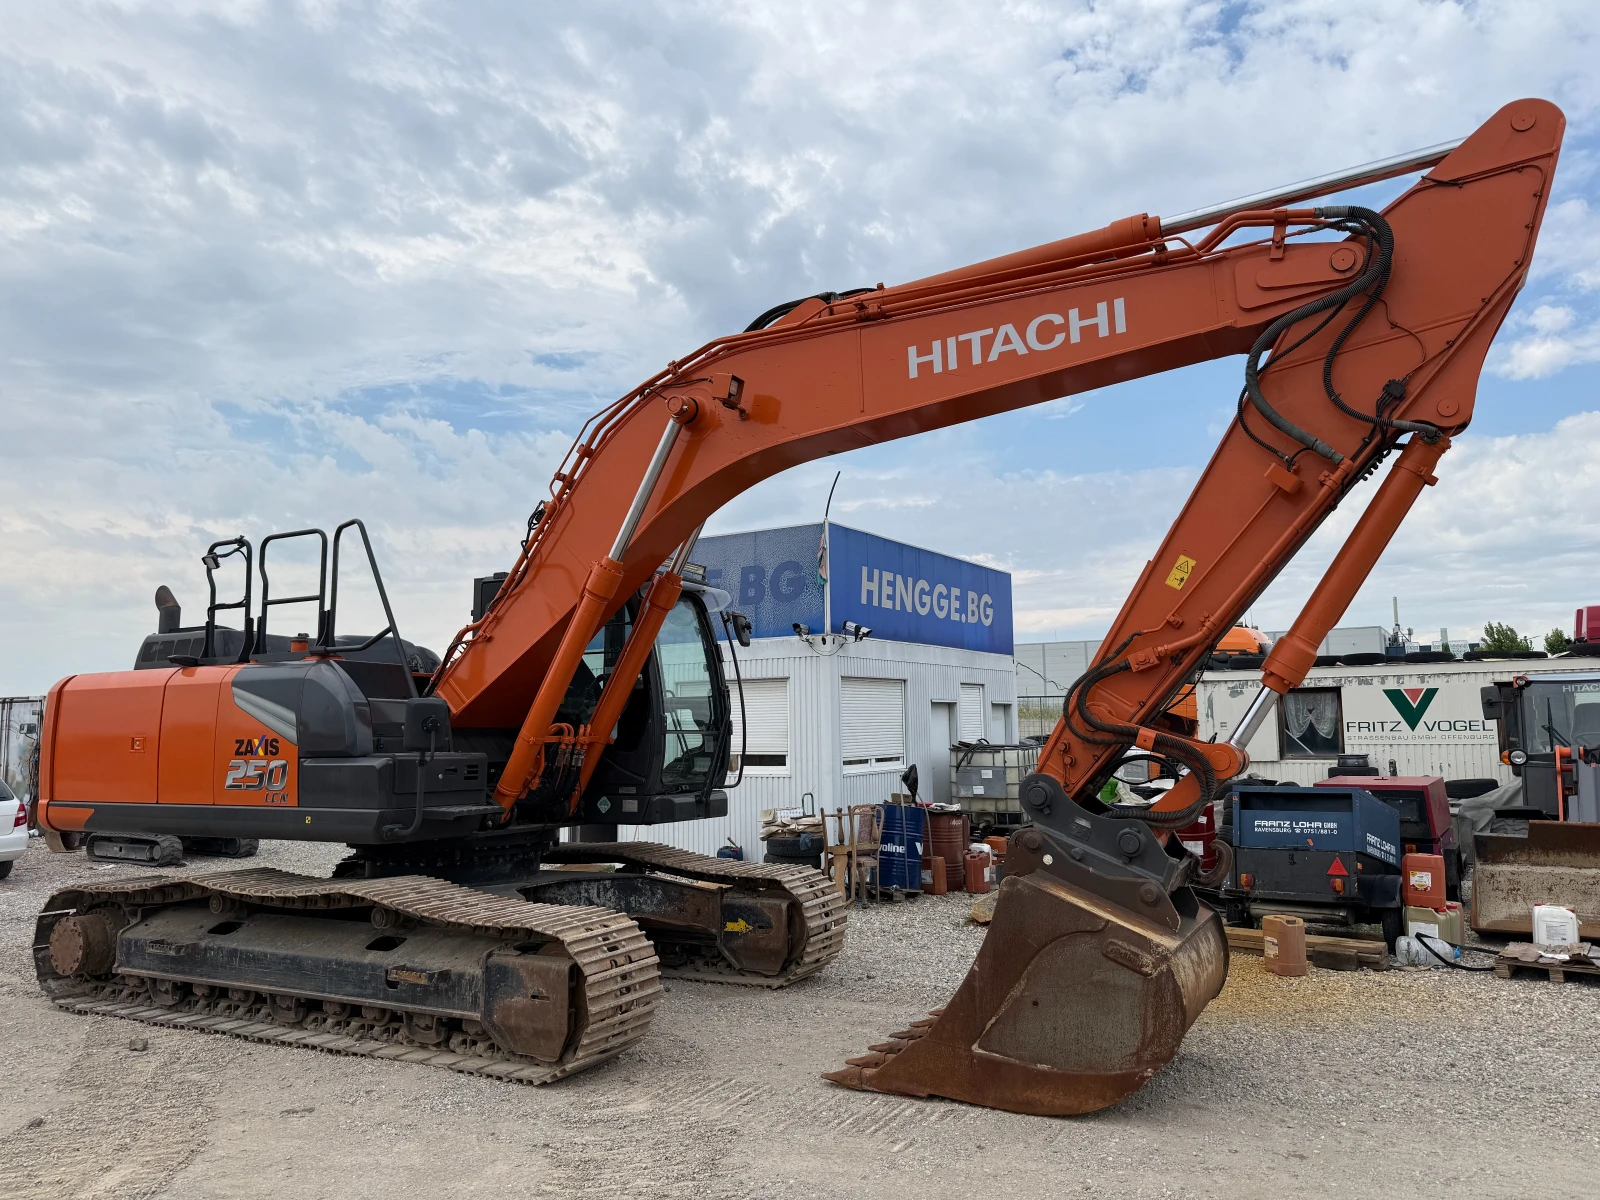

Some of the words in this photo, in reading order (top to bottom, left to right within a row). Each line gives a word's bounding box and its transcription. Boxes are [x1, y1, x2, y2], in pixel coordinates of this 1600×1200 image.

[907, 297, 1127, 379] HITACHI
[861, 565, 994, 627] HENGGE.BG
[1562, 683, 1600, 693] HITAC
[1346, 721, 1403, 733] FRITZ
[1423, 720, 1494, 732] VOGEL
[234, 735, 280, 756] ZAXIS
[224, 759, 289, 791] 250
[1254, 820, 1291, 828] FRANZ
[1292, 821, 1322, 829] LOHR
